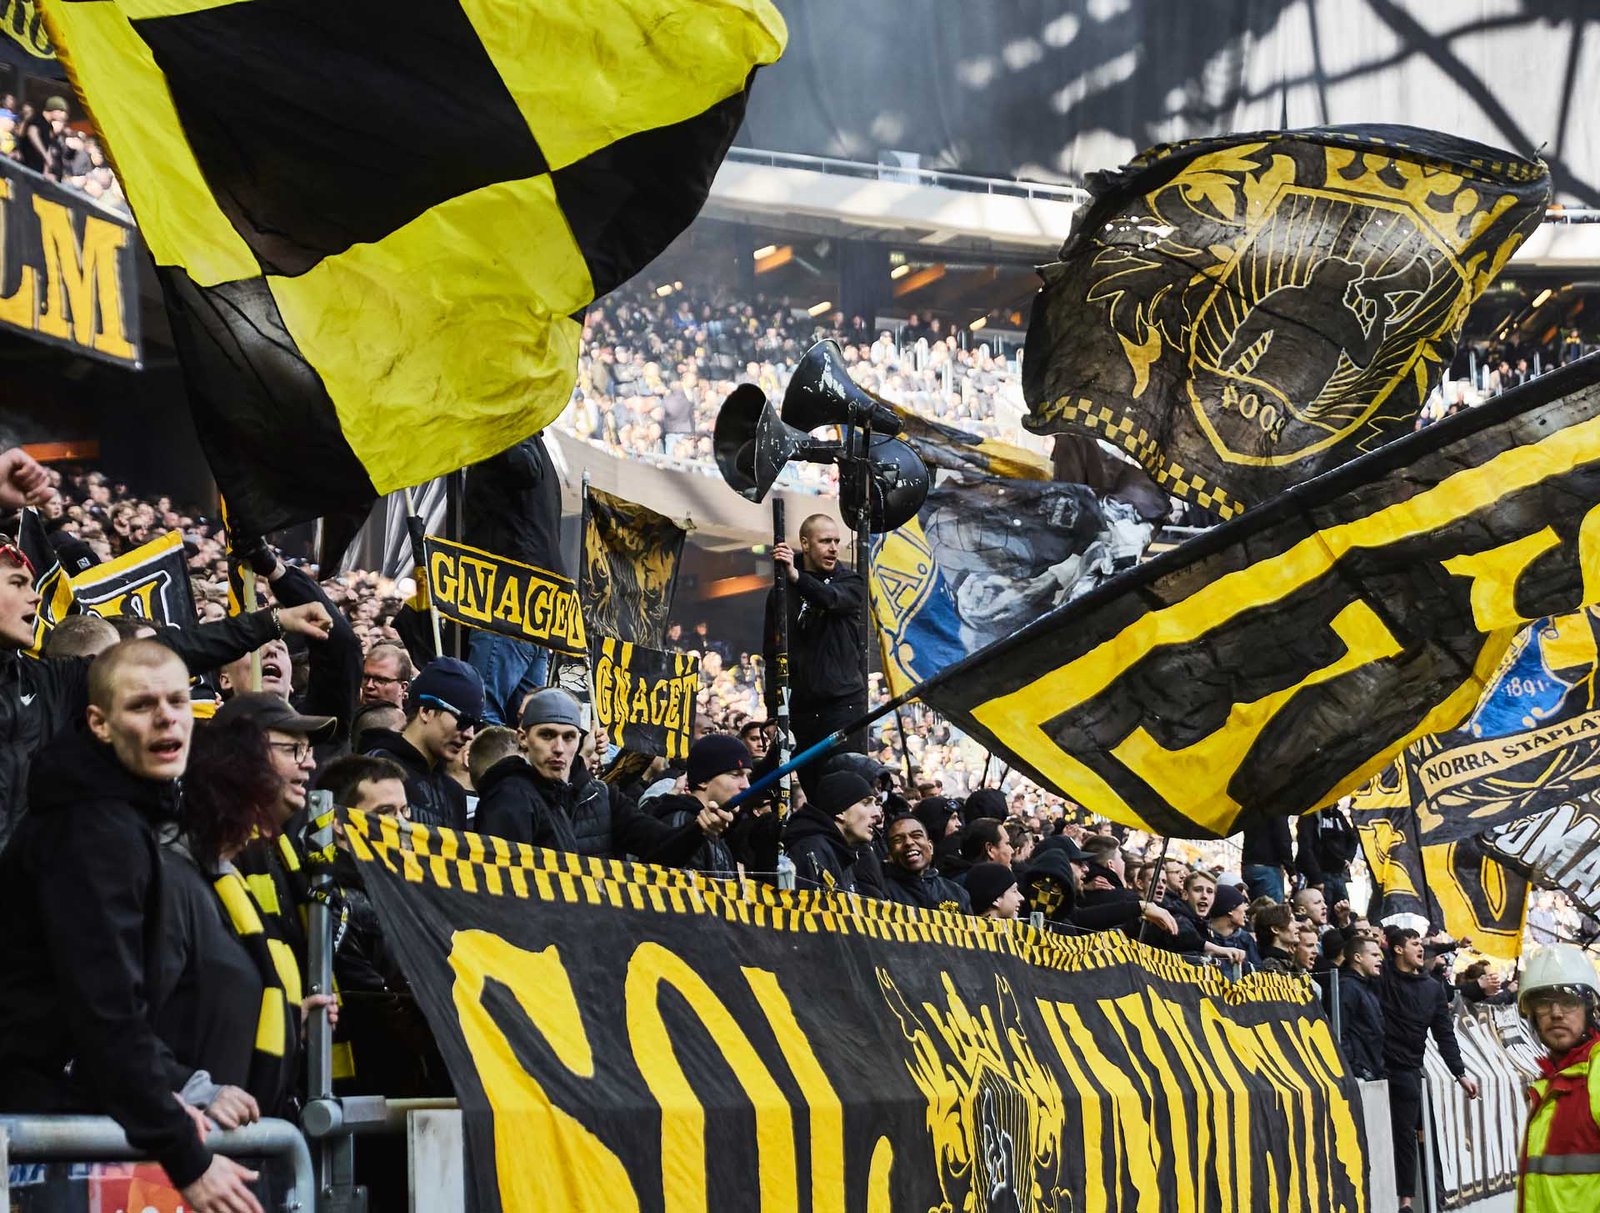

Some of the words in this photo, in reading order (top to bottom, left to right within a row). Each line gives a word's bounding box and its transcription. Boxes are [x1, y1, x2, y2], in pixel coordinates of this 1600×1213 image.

[431, 551, 587, 649] GNAGET
[596, 655, 698, 734] GNAGET
[1425, 751, 1499, 785] NORRA
